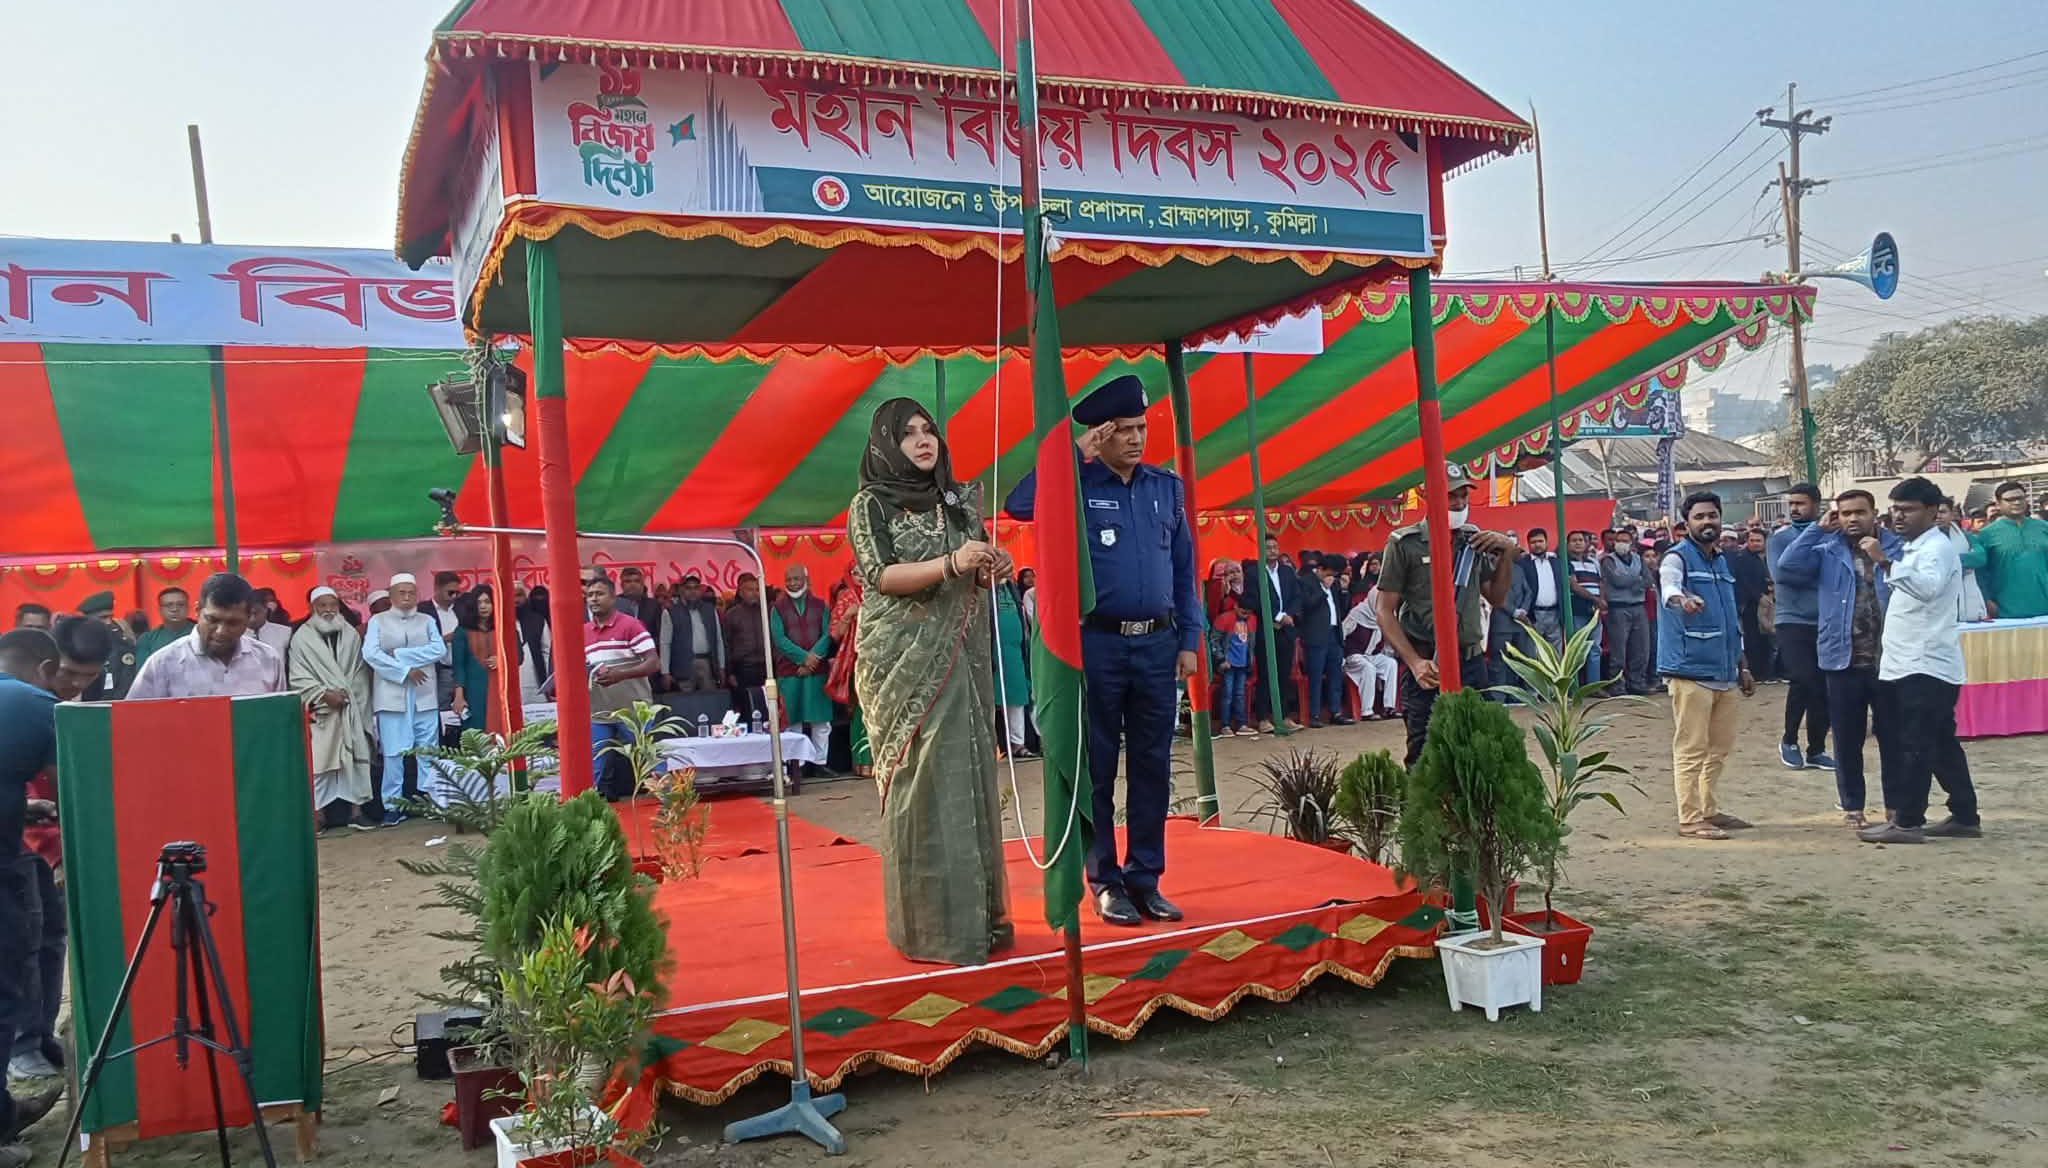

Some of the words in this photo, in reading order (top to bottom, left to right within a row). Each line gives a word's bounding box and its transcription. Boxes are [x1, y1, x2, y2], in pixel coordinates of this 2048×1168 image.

[567, 102, 655, 164] বিজয়
[614, 108, 647, 124] মহান
[759, 78, 921, 162] মহান
[1100, 108, 1241, 184] দিবস
[1258, 127, 1400, 201] ২০২৫
[579, 141, 655, 197] দিবস
[863, 183, 967, 212] আয়োজনে
